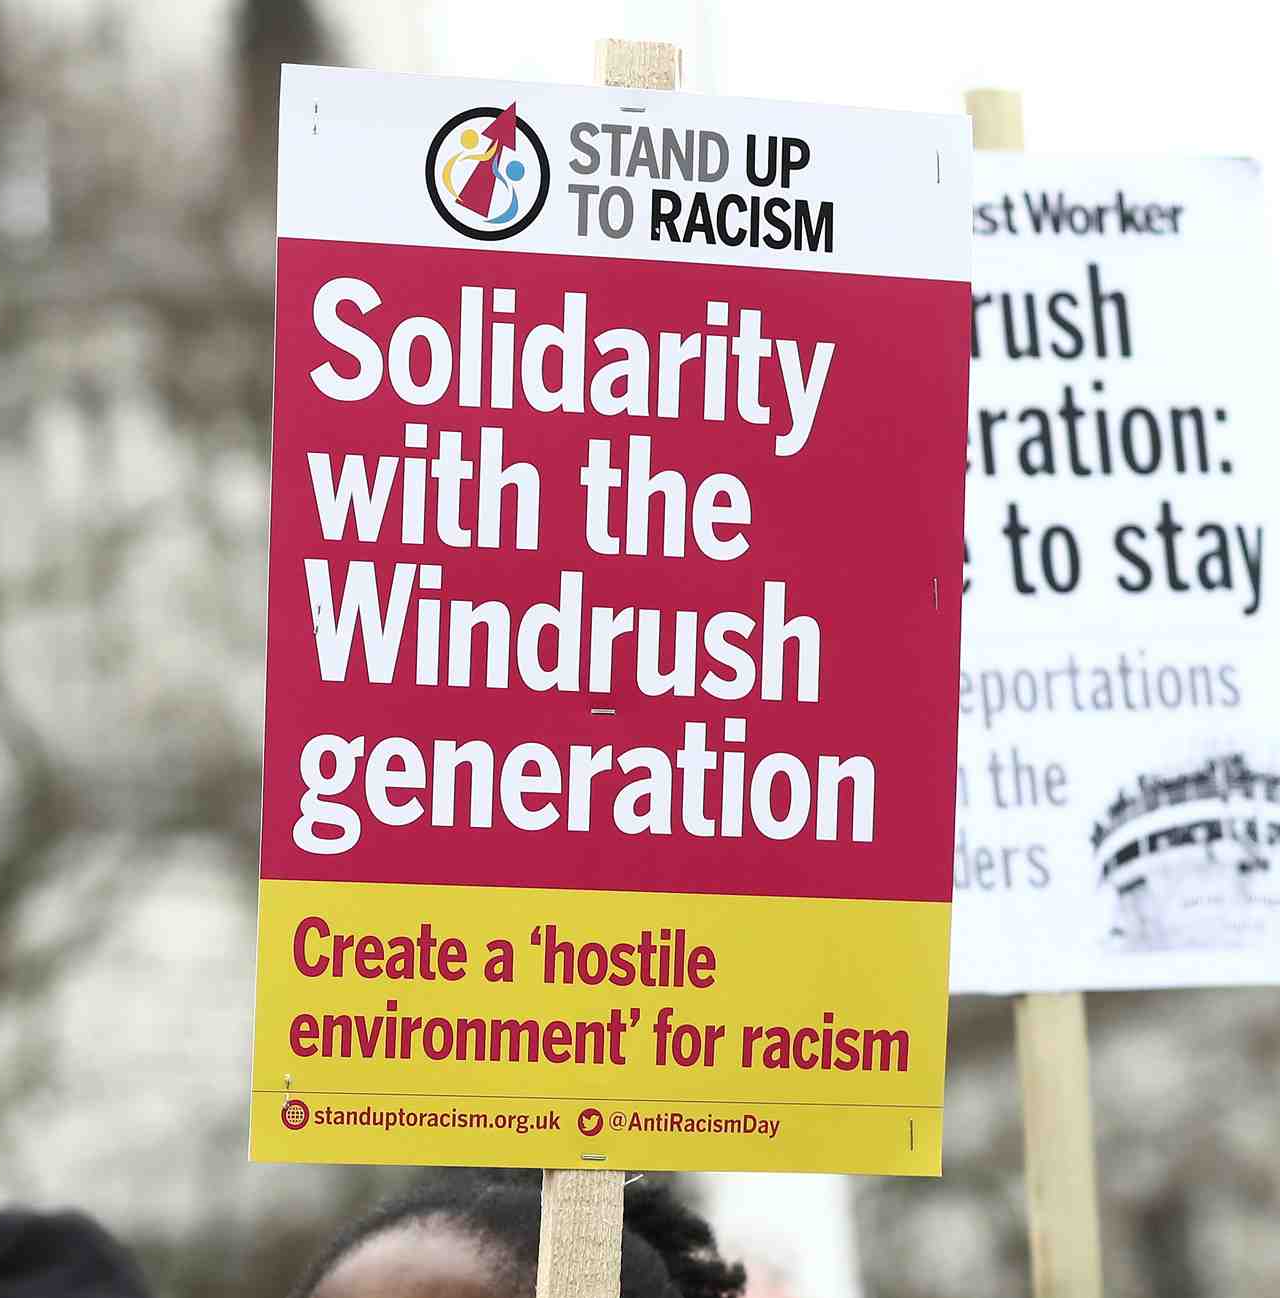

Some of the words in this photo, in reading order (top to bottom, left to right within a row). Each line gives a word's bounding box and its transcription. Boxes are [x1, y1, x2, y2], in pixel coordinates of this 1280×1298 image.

[569, 122, 729, 182] STAND
[747, 134, 810, 188] UP
[568, 184, 633, 239] TO
[651, 189, 833, 253] RACISM
[1024, 191, 1185, 235] Worker
[971, 262, 1131, 358] rush
[310, 278, 835, 456] Solidarity
[307, 424, 539, 549] with
[581, 435, 751, 560] the
[1003, 503, 1080, 595] to
[1114, 501, 1261, 616] stay
[304, 559, 820, 702] Windrush
[293, 718, 874, 854] generation
[989, 745, 1067, 808] the
[294, 917, 467, 981] Create
[484, 940, 513, 982] a
[653, 1007, 725, 1066] for
[742, 1012, 909, 1072] racism
[315, 1107, 560, 1133] standuptoracism.org.uk
[609, 1112, 779, 1138] @AntiRacismDay
